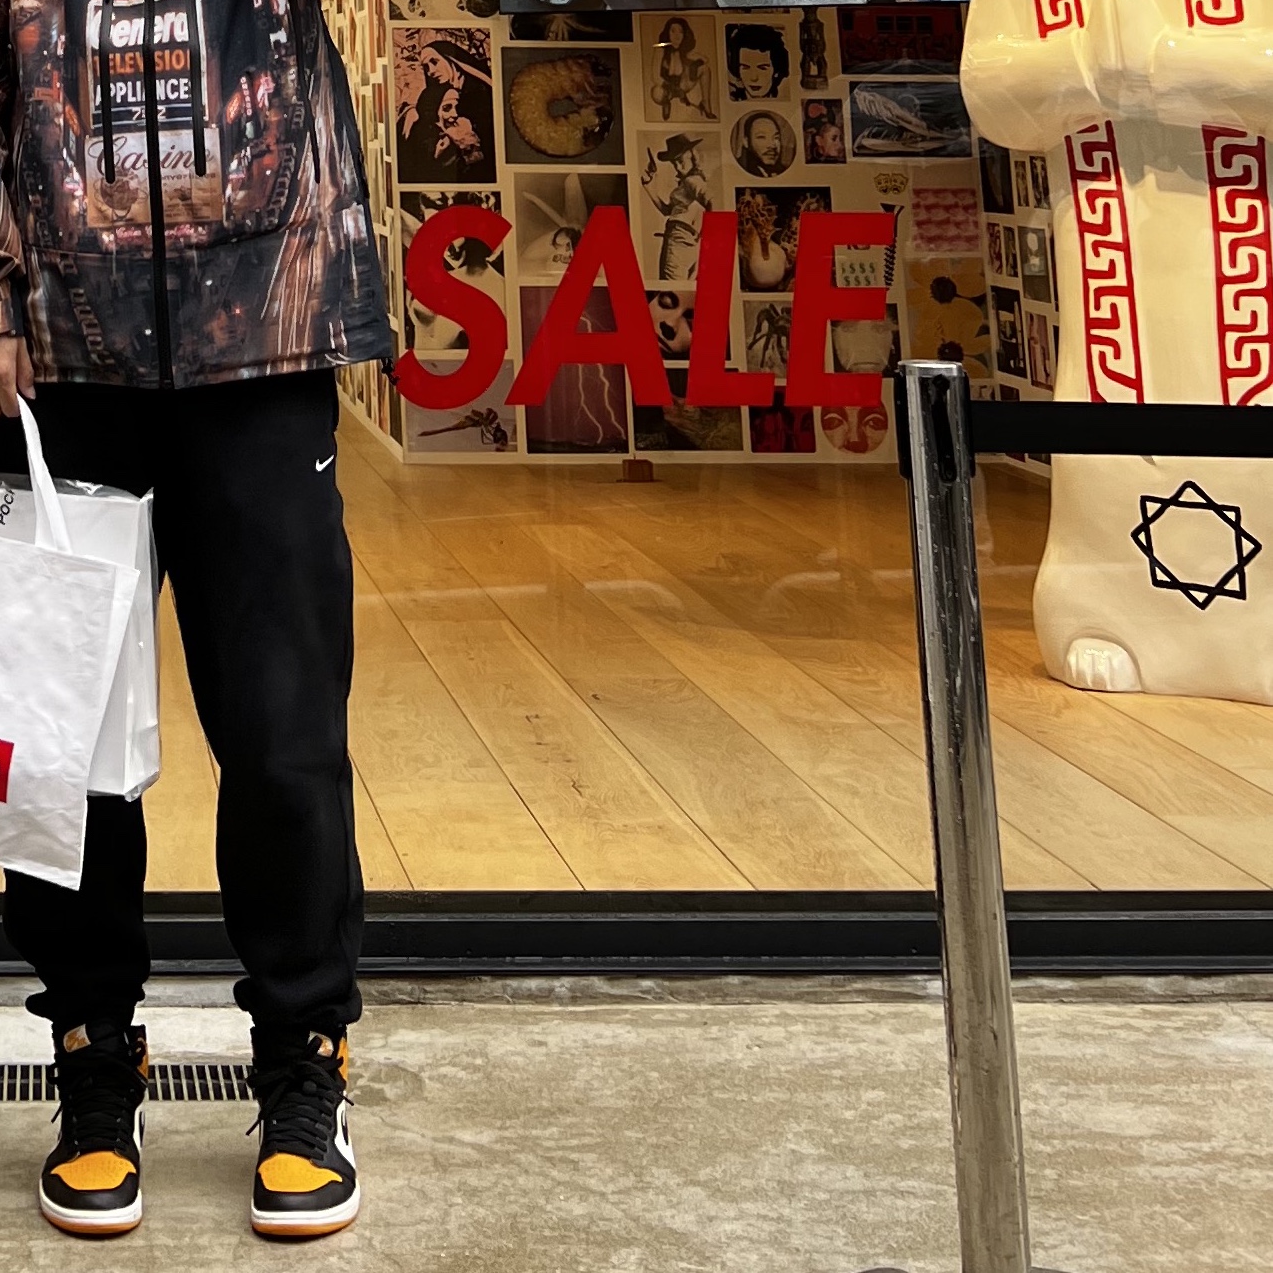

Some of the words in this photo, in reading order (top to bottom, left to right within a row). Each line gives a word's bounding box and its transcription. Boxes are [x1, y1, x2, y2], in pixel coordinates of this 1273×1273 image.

[90, 10, 190, 49] Genera
[92, 48, 191, 76] TELEVSIO
[95, 77, 192, 106] APPLINCE
[87, 135, 214, 177] Cain
[394, 204, 894, 410] SALE
